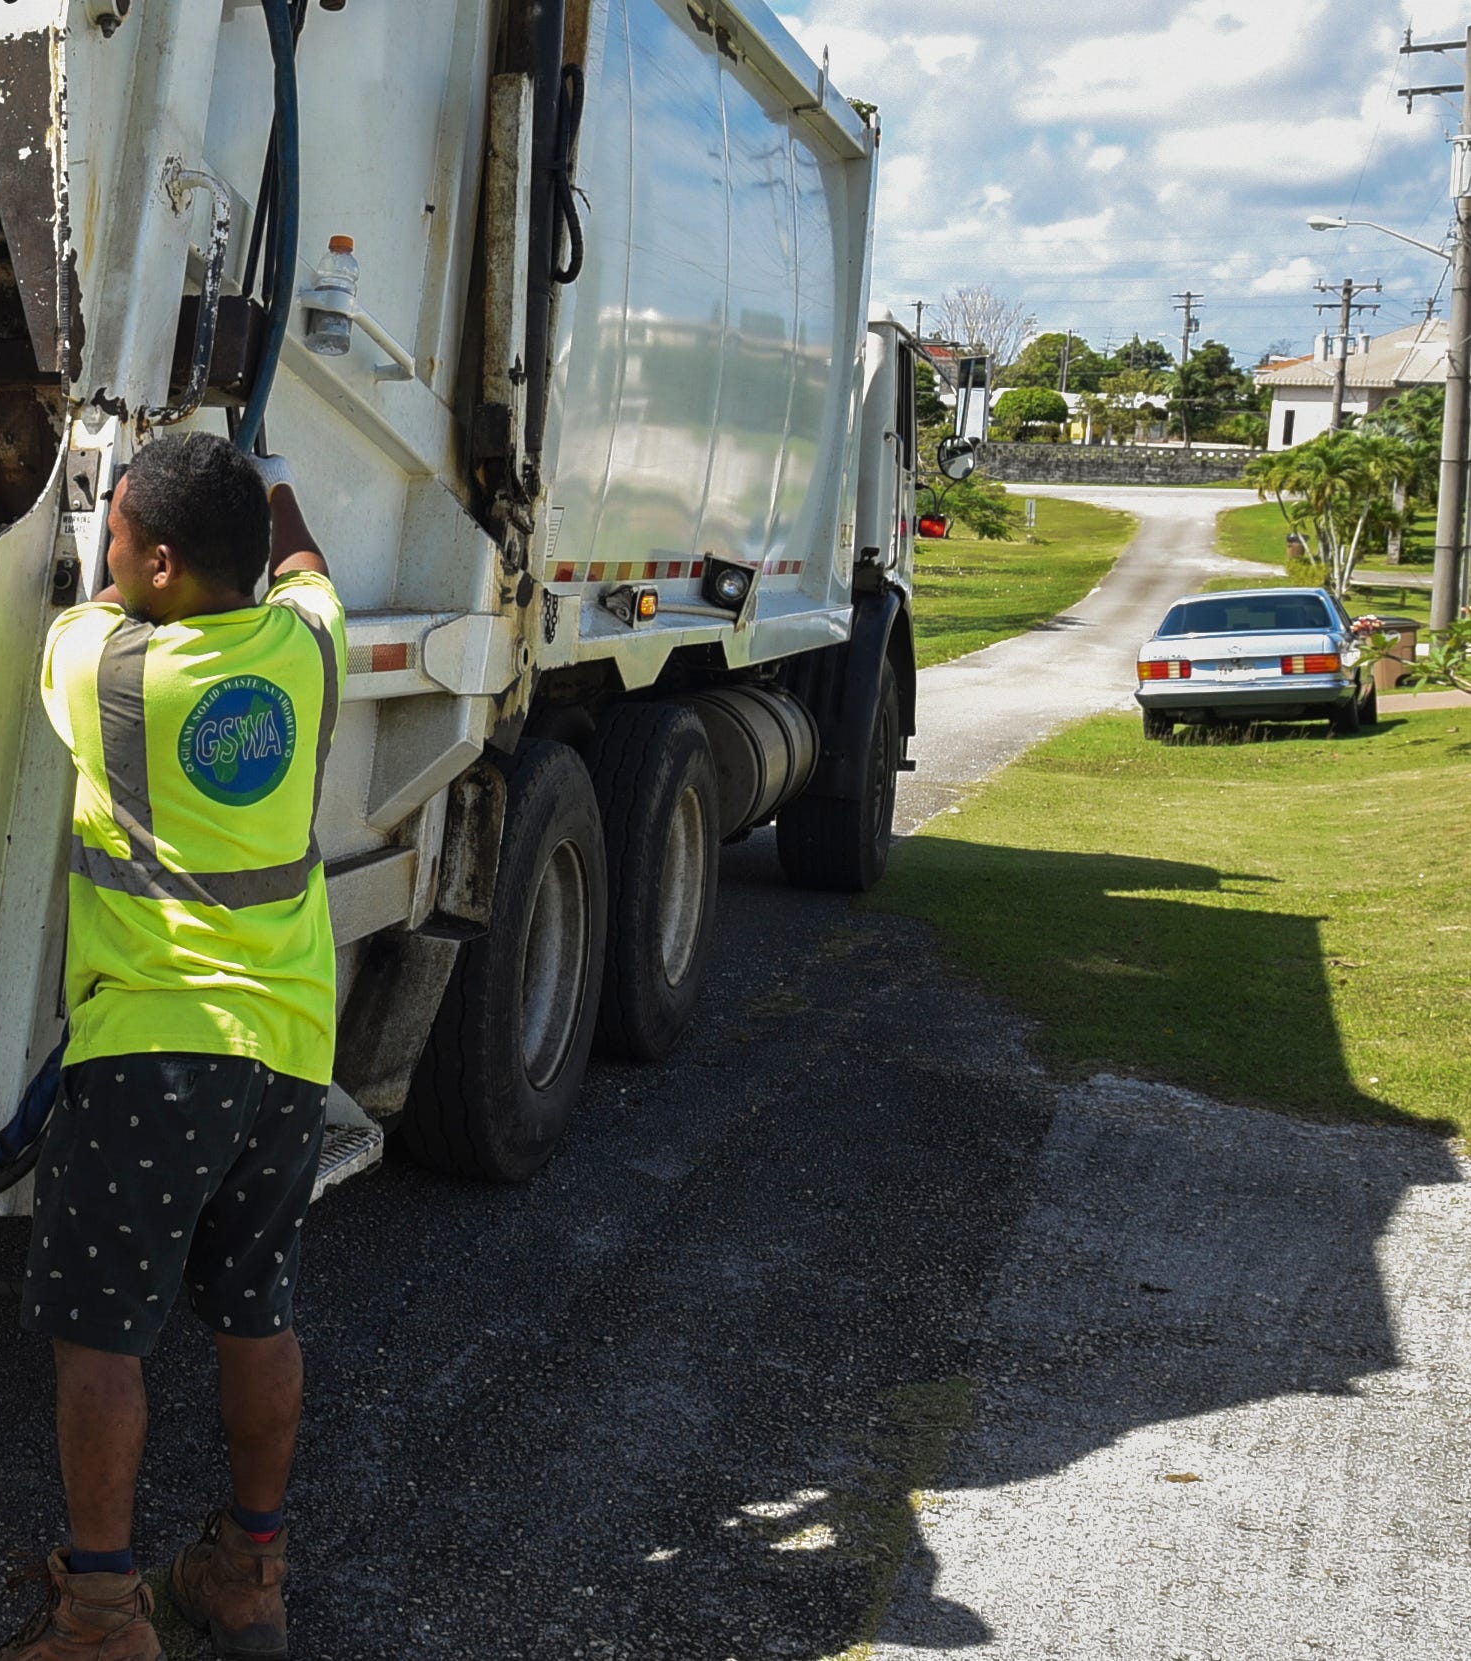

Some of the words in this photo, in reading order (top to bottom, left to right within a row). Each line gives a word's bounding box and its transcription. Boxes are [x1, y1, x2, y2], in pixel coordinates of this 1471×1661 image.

[180, 725, 195, 761] GUAM
[192, 688, 221, 721] SOLID
[222, 678, 260, 691] WASTE
[263, 684, 295, 745] AUTHORITY
[196, 710, 282, 766] GSWA
